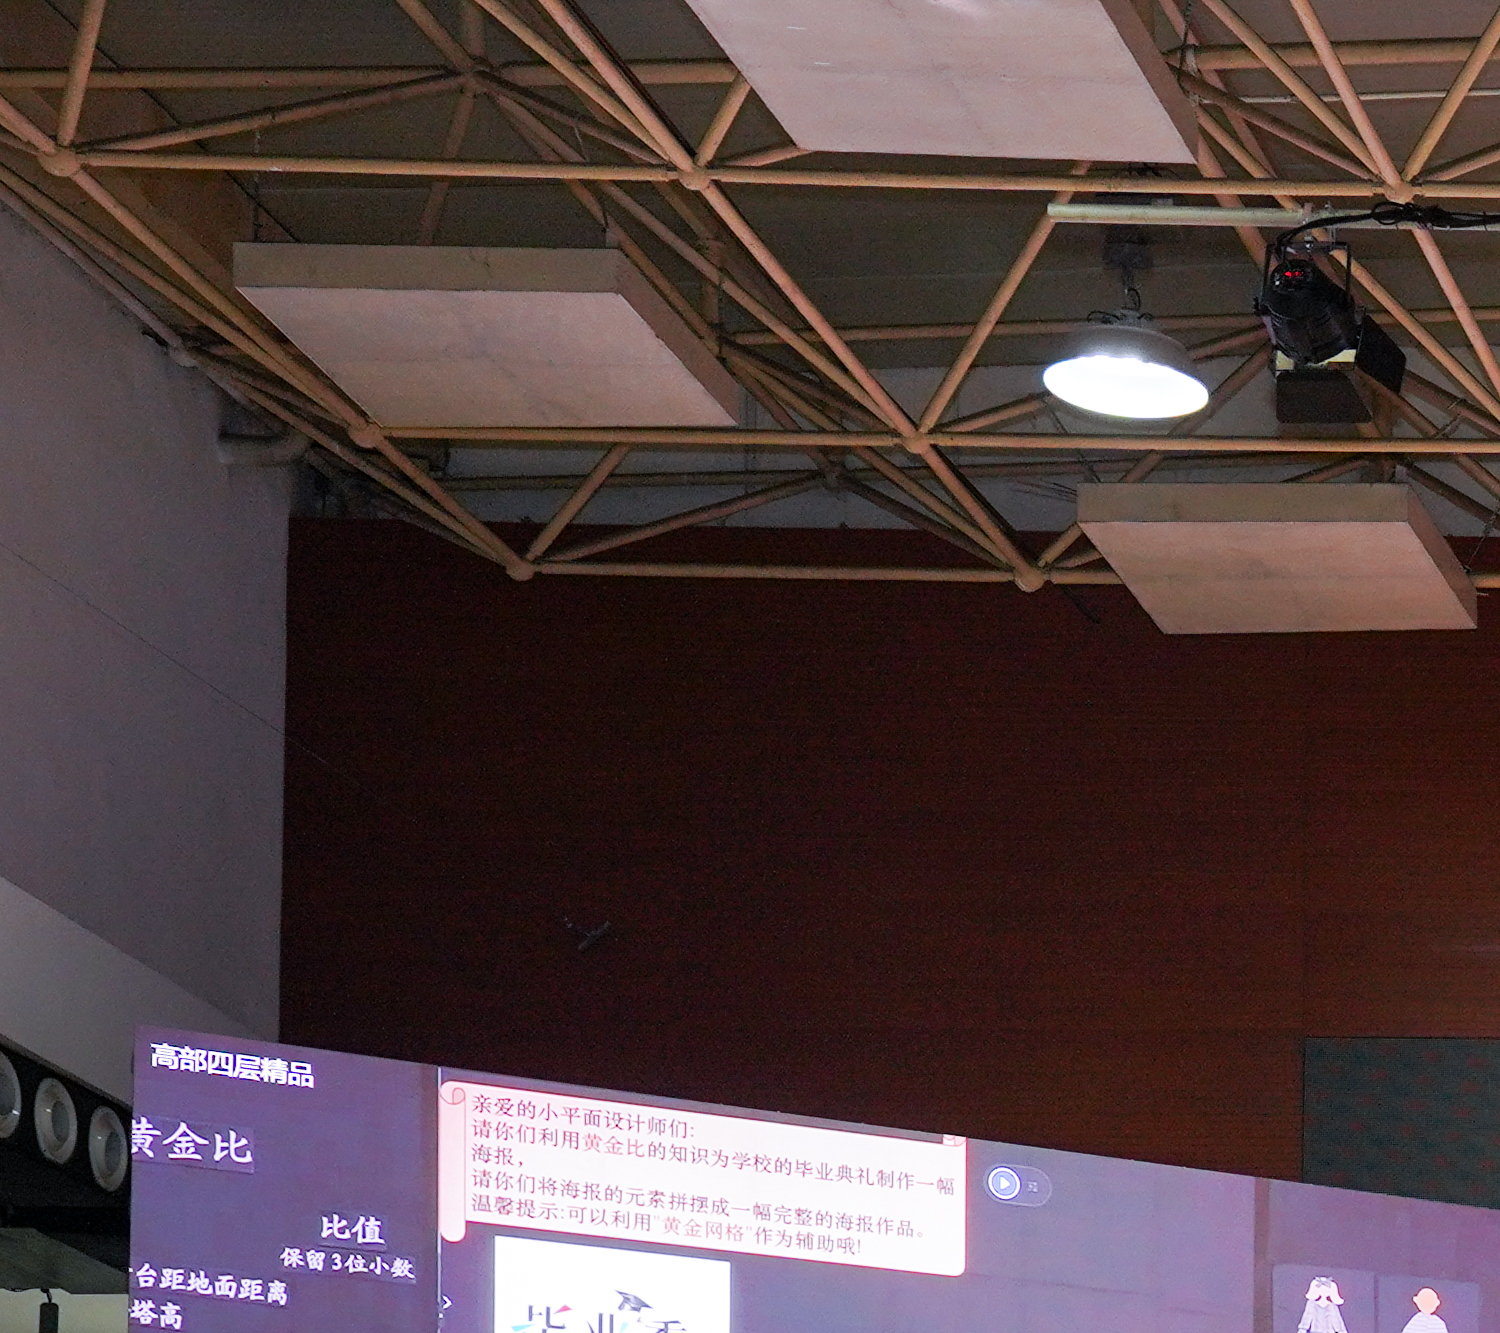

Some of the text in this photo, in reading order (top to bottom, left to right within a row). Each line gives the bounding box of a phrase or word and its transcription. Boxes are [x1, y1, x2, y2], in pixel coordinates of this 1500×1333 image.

[150, 1042, 315, 1089] 高部四层精品
[320, 1213, 387, 1245] 比值
[129, 1263, 288, 1307] 台距地面距离
